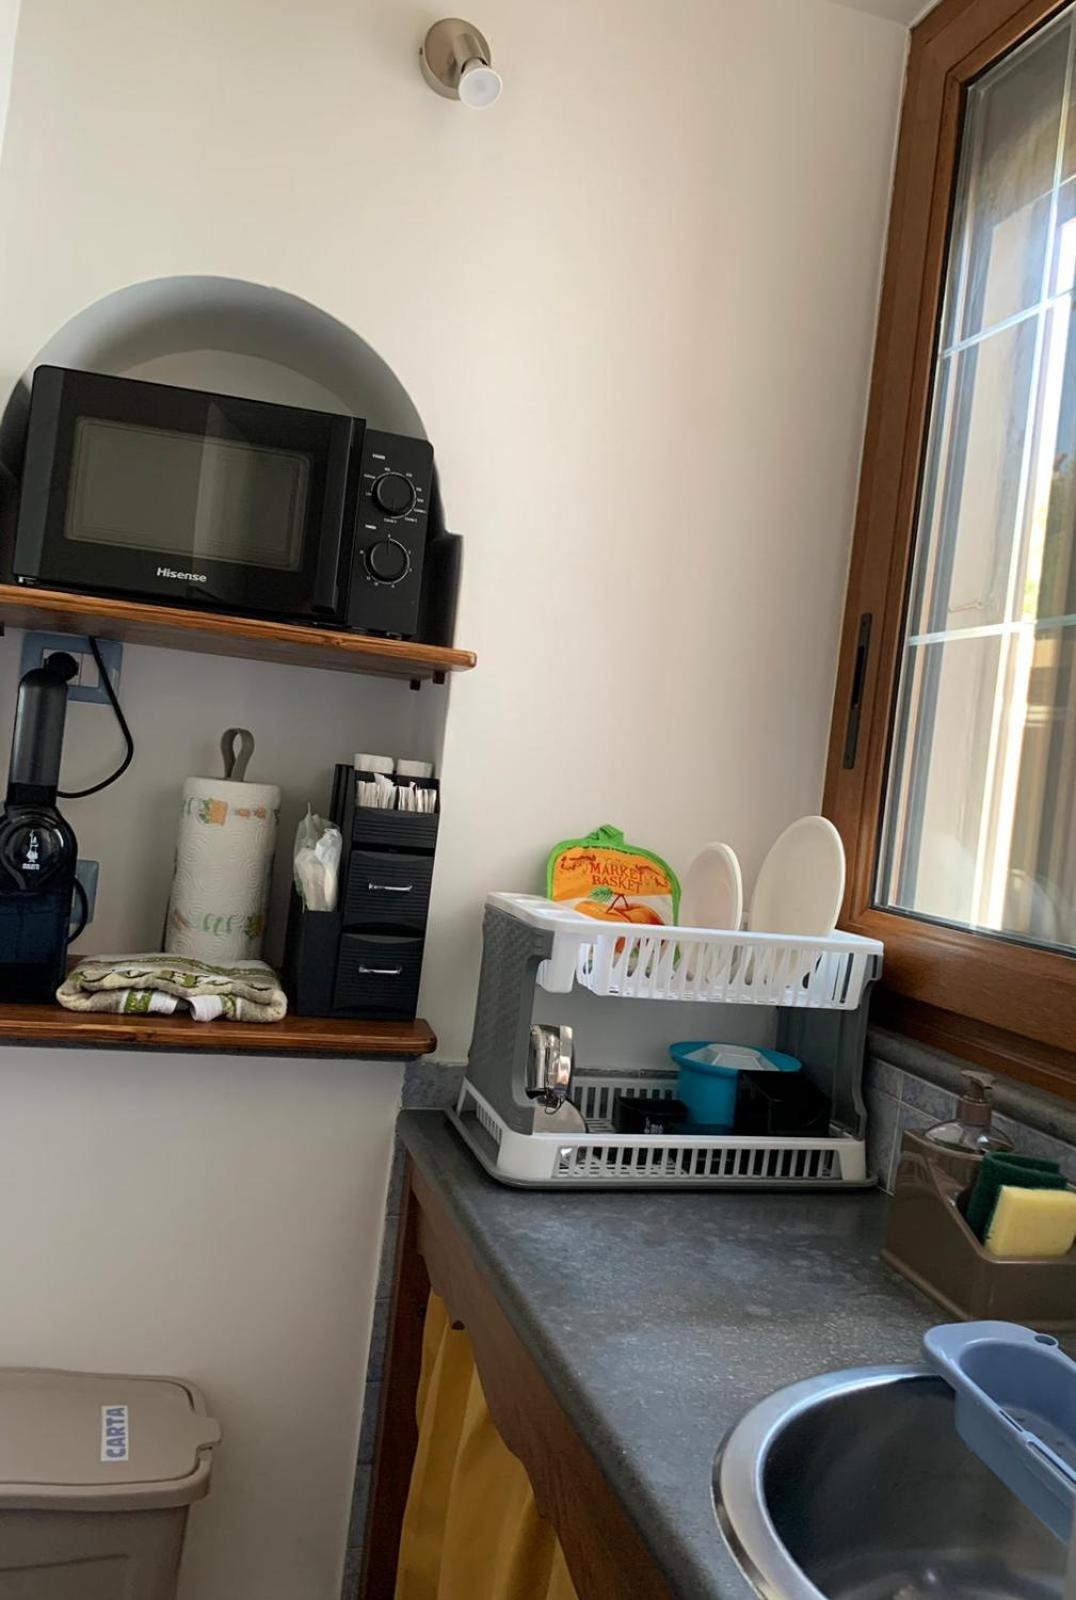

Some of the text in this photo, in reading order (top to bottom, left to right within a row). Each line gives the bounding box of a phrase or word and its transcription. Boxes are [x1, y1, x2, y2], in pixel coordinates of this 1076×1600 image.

[156, 567, 207, 582] Hisense
[591, 862, 642, 882] MARKET
[592, 875, 641, 893] BASKET
[106, 1407, 126, 1458] CARTA
